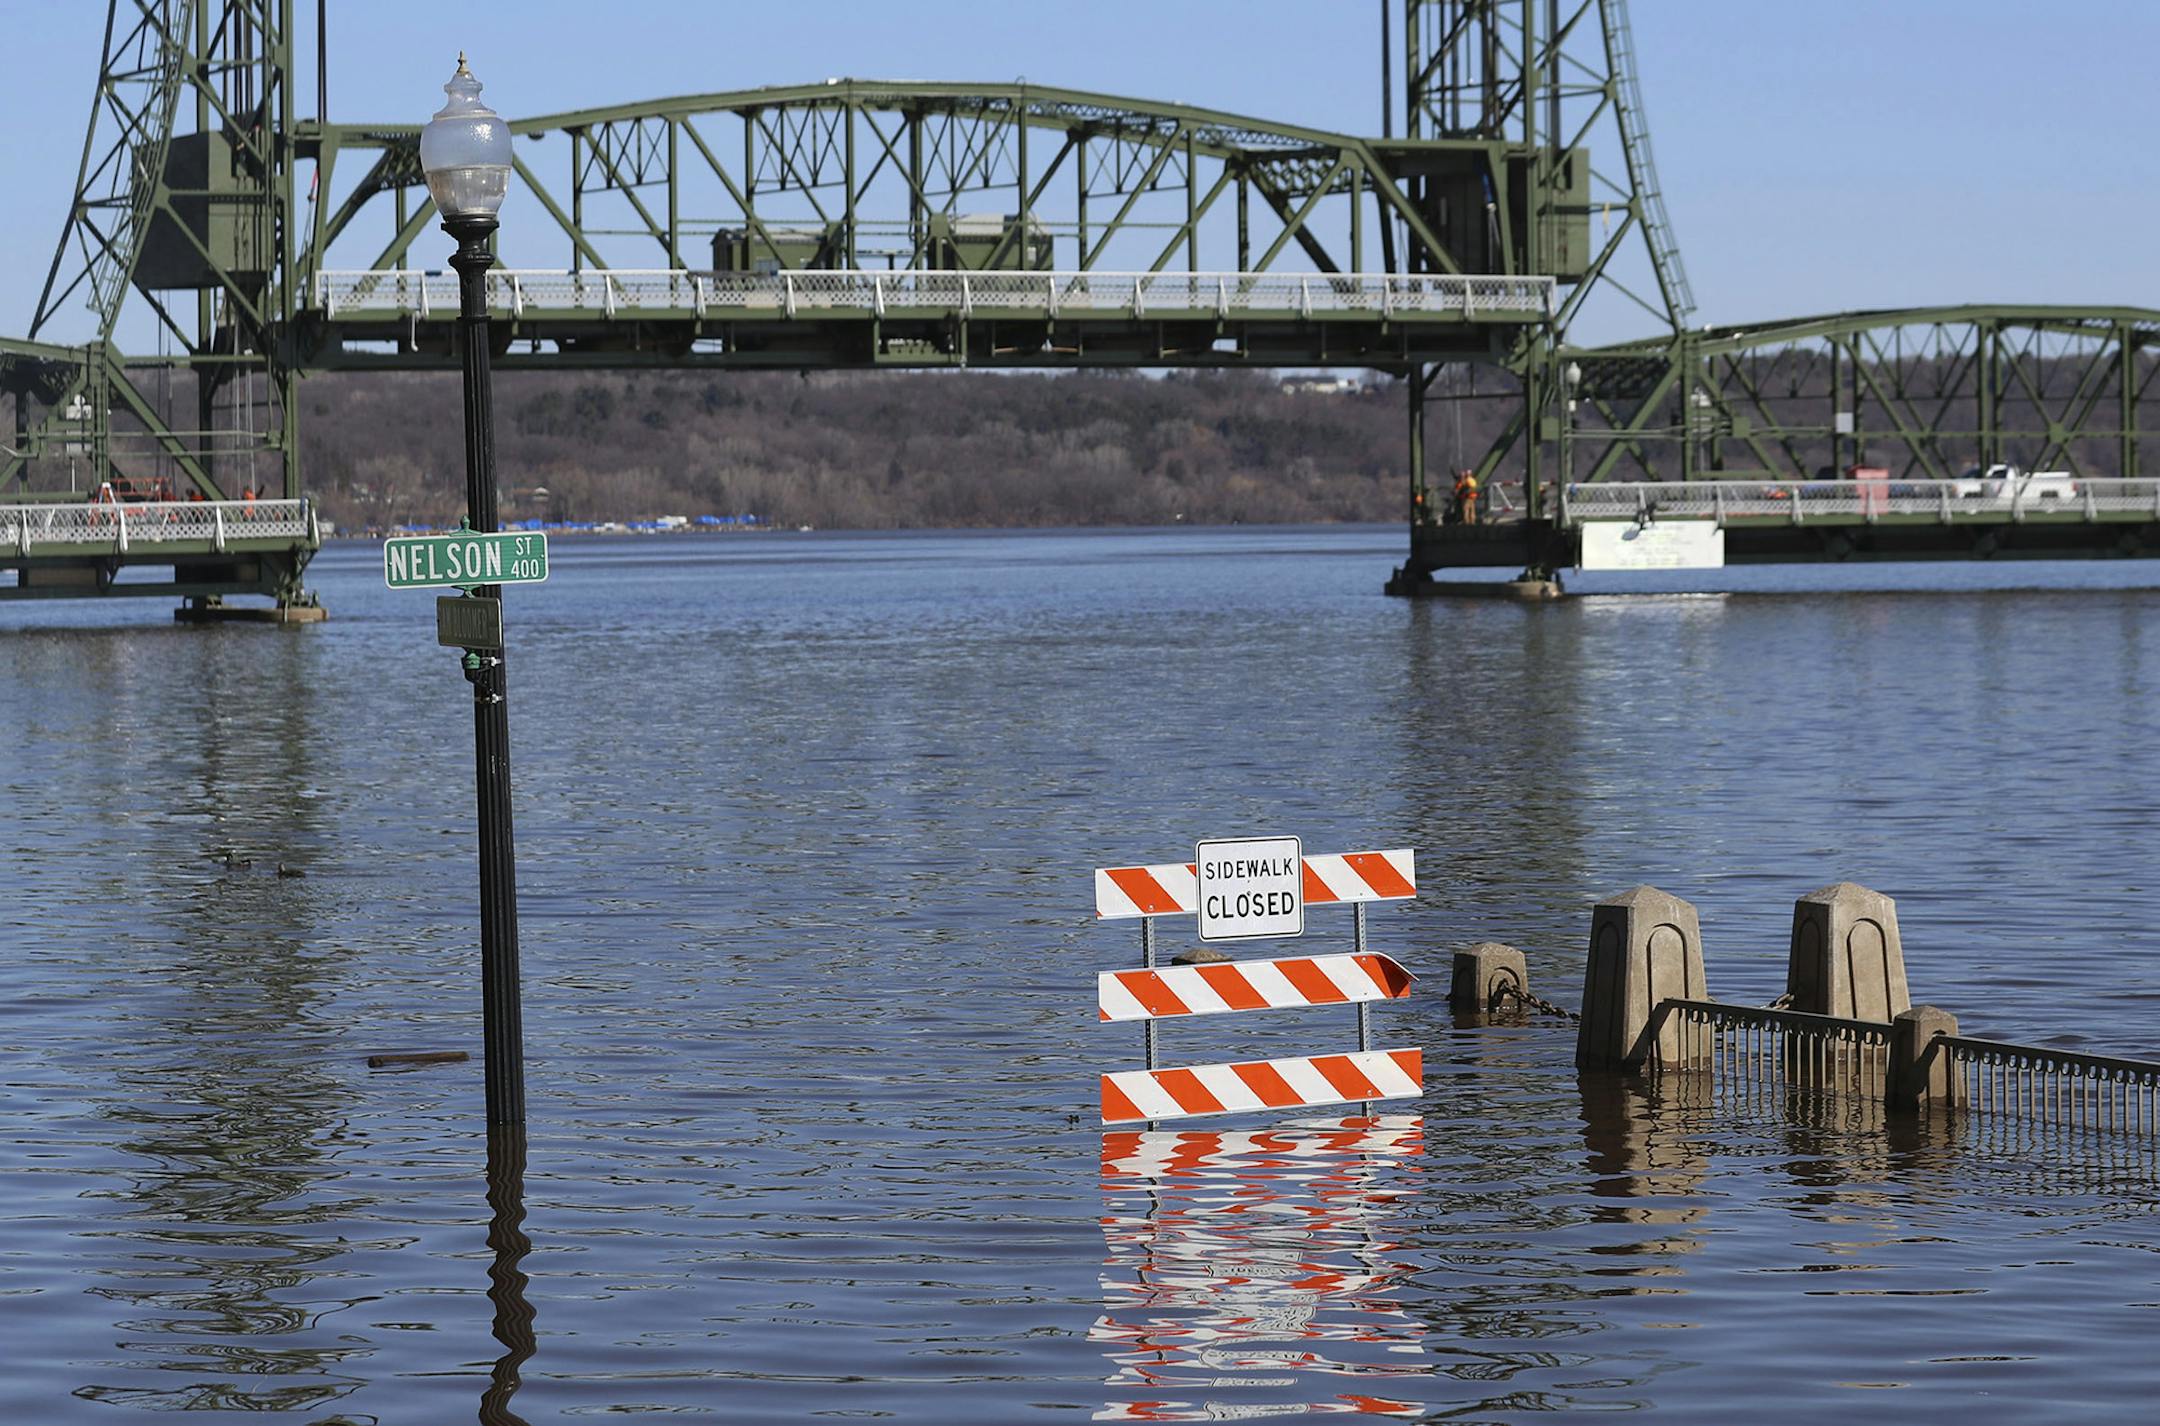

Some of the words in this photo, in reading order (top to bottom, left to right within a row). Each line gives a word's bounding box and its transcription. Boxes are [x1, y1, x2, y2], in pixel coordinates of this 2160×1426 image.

[391, 541, 502, 581] NELSON
[516, 537, 532, 556] ST
[511, 559, 538, 578] 400
[1206, 857, 1293, 880] SIDEWALK
[1207, 891, 1294, 919] CLOSED
